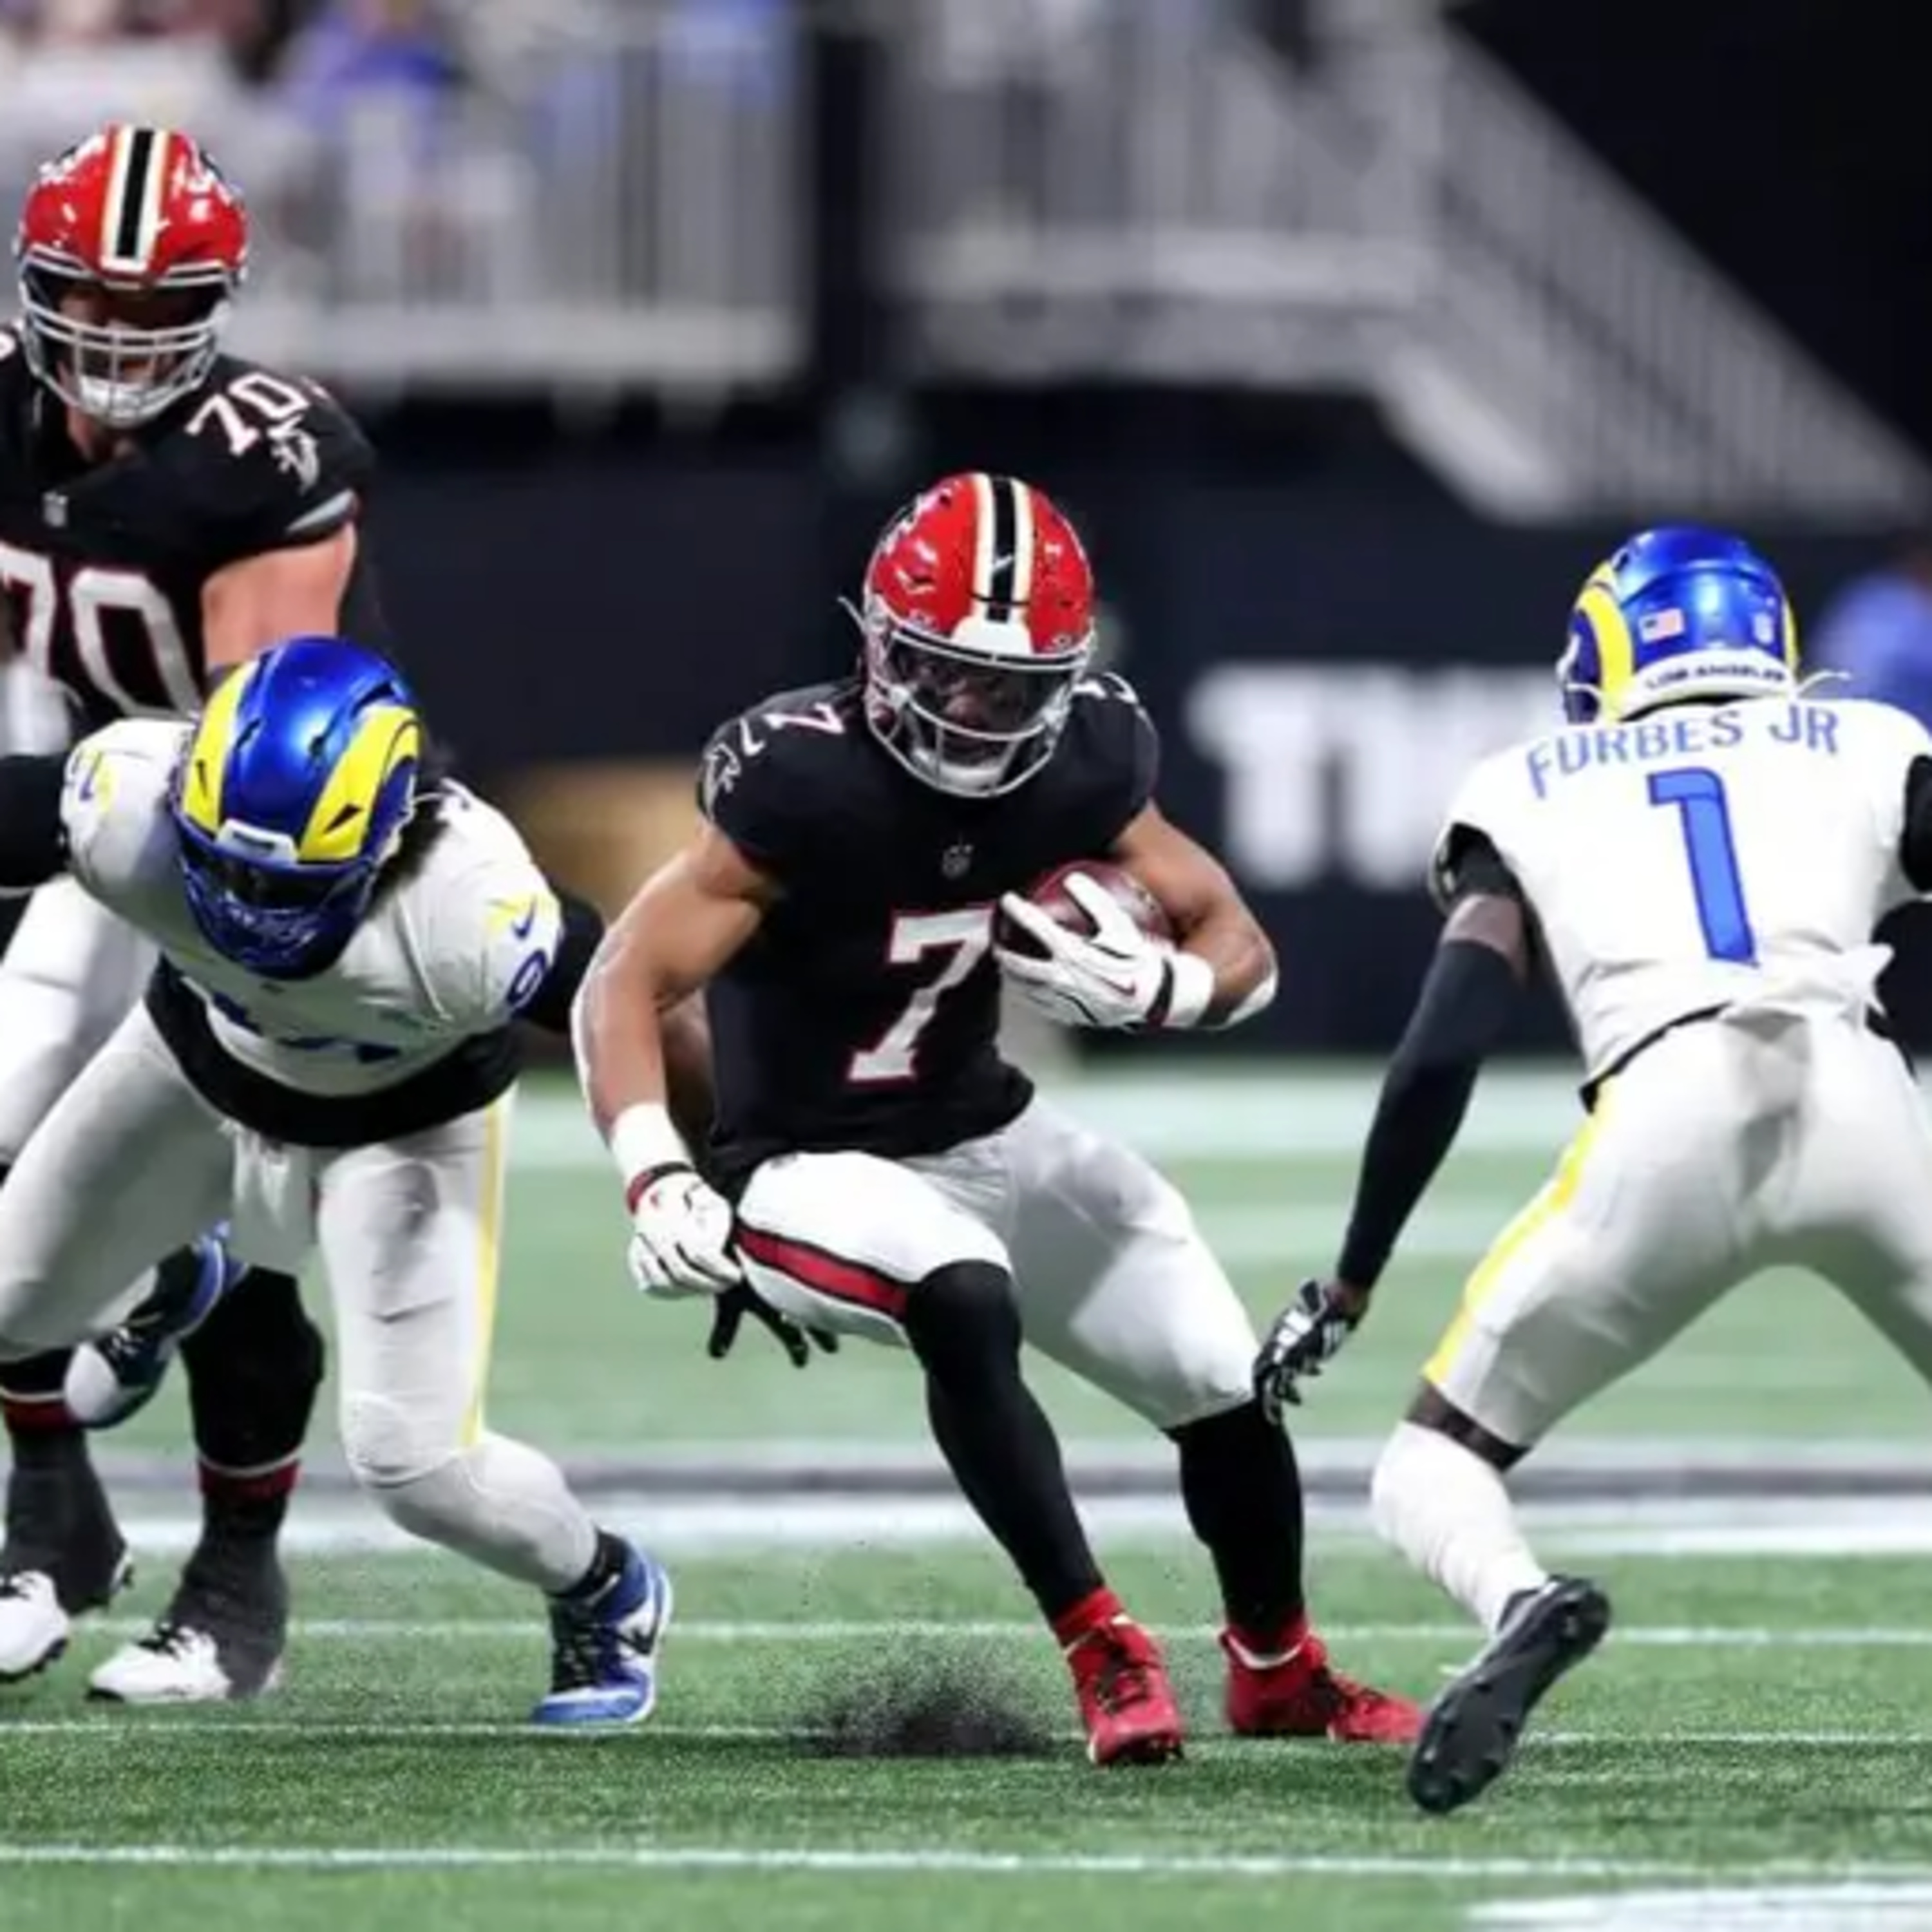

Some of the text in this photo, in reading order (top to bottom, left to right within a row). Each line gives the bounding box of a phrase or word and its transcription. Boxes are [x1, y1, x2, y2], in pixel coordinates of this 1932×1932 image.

[185, 372, 310, 456] 70
[1768, 705, 1839, 755] JR
[1647, 766, 1759, 967] 1
[848, 904, 994, 1087] 7
